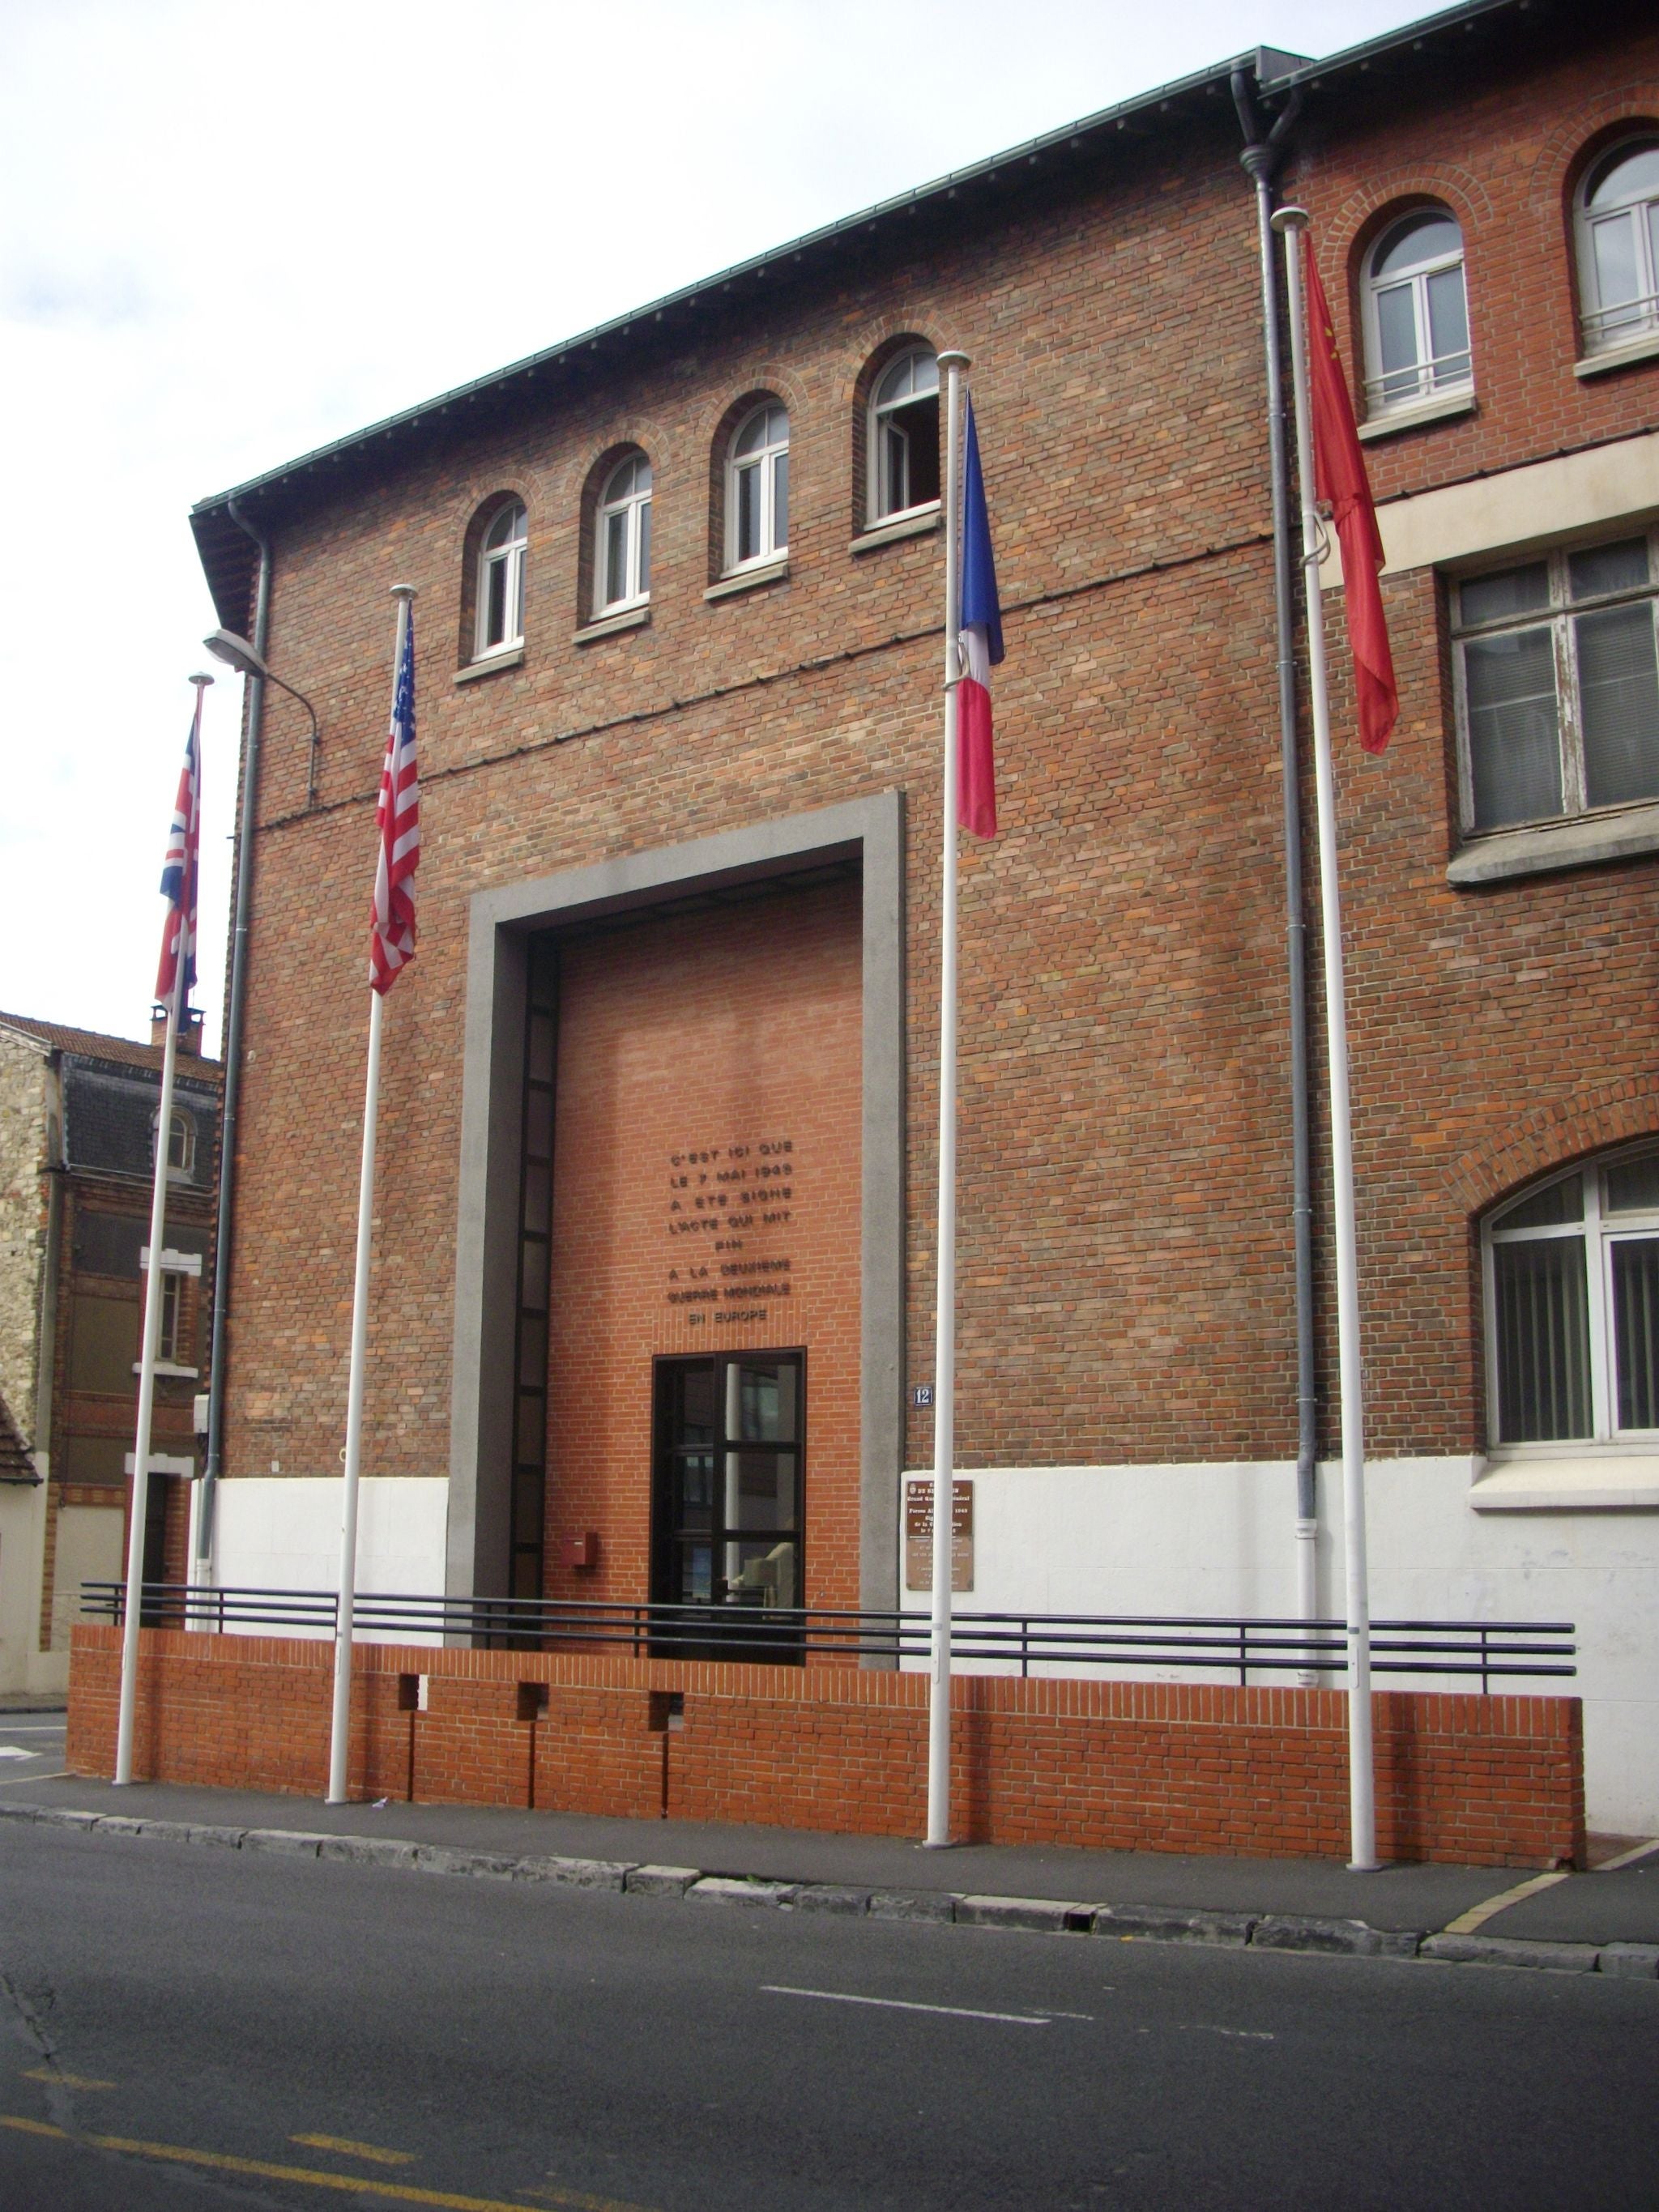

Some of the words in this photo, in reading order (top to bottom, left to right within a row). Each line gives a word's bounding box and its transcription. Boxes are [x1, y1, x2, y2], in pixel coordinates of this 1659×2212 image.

[671, 1149, 719, 1166] C'EST
[728, 1146, 749, 1157] ICI
[759, 1140, 792, 1153] QUE
[670, 1176, 689, 1189] LE
[699, 1174, 706, 1185] 7
[717, 1170, 746, 1183] MAI
[755, 1164, 792, 1178] 1945
[671, 1200, 681, 1212] A
[669, 1217, 719, 1235] L'ACTE
[727, 1214, 753, 1229] QUI
[763, 1211, 791, 1225] MIT
[715, 1240, 743, 1251] FIN
[668, 1268, 679, 1281] A
[690, 1265, 709, 1279] LA
[720, 1258, 791, 1276] DEUXIEME
[668, 1289, 718, 1303] GUERRE
[724, 1283, 791, 1298] MONDIALE
[689, 1312, 706, 1325] EN
[714, 1309, 768, 1323] EUROPE
[916, 1388, 929, 1404] 12
